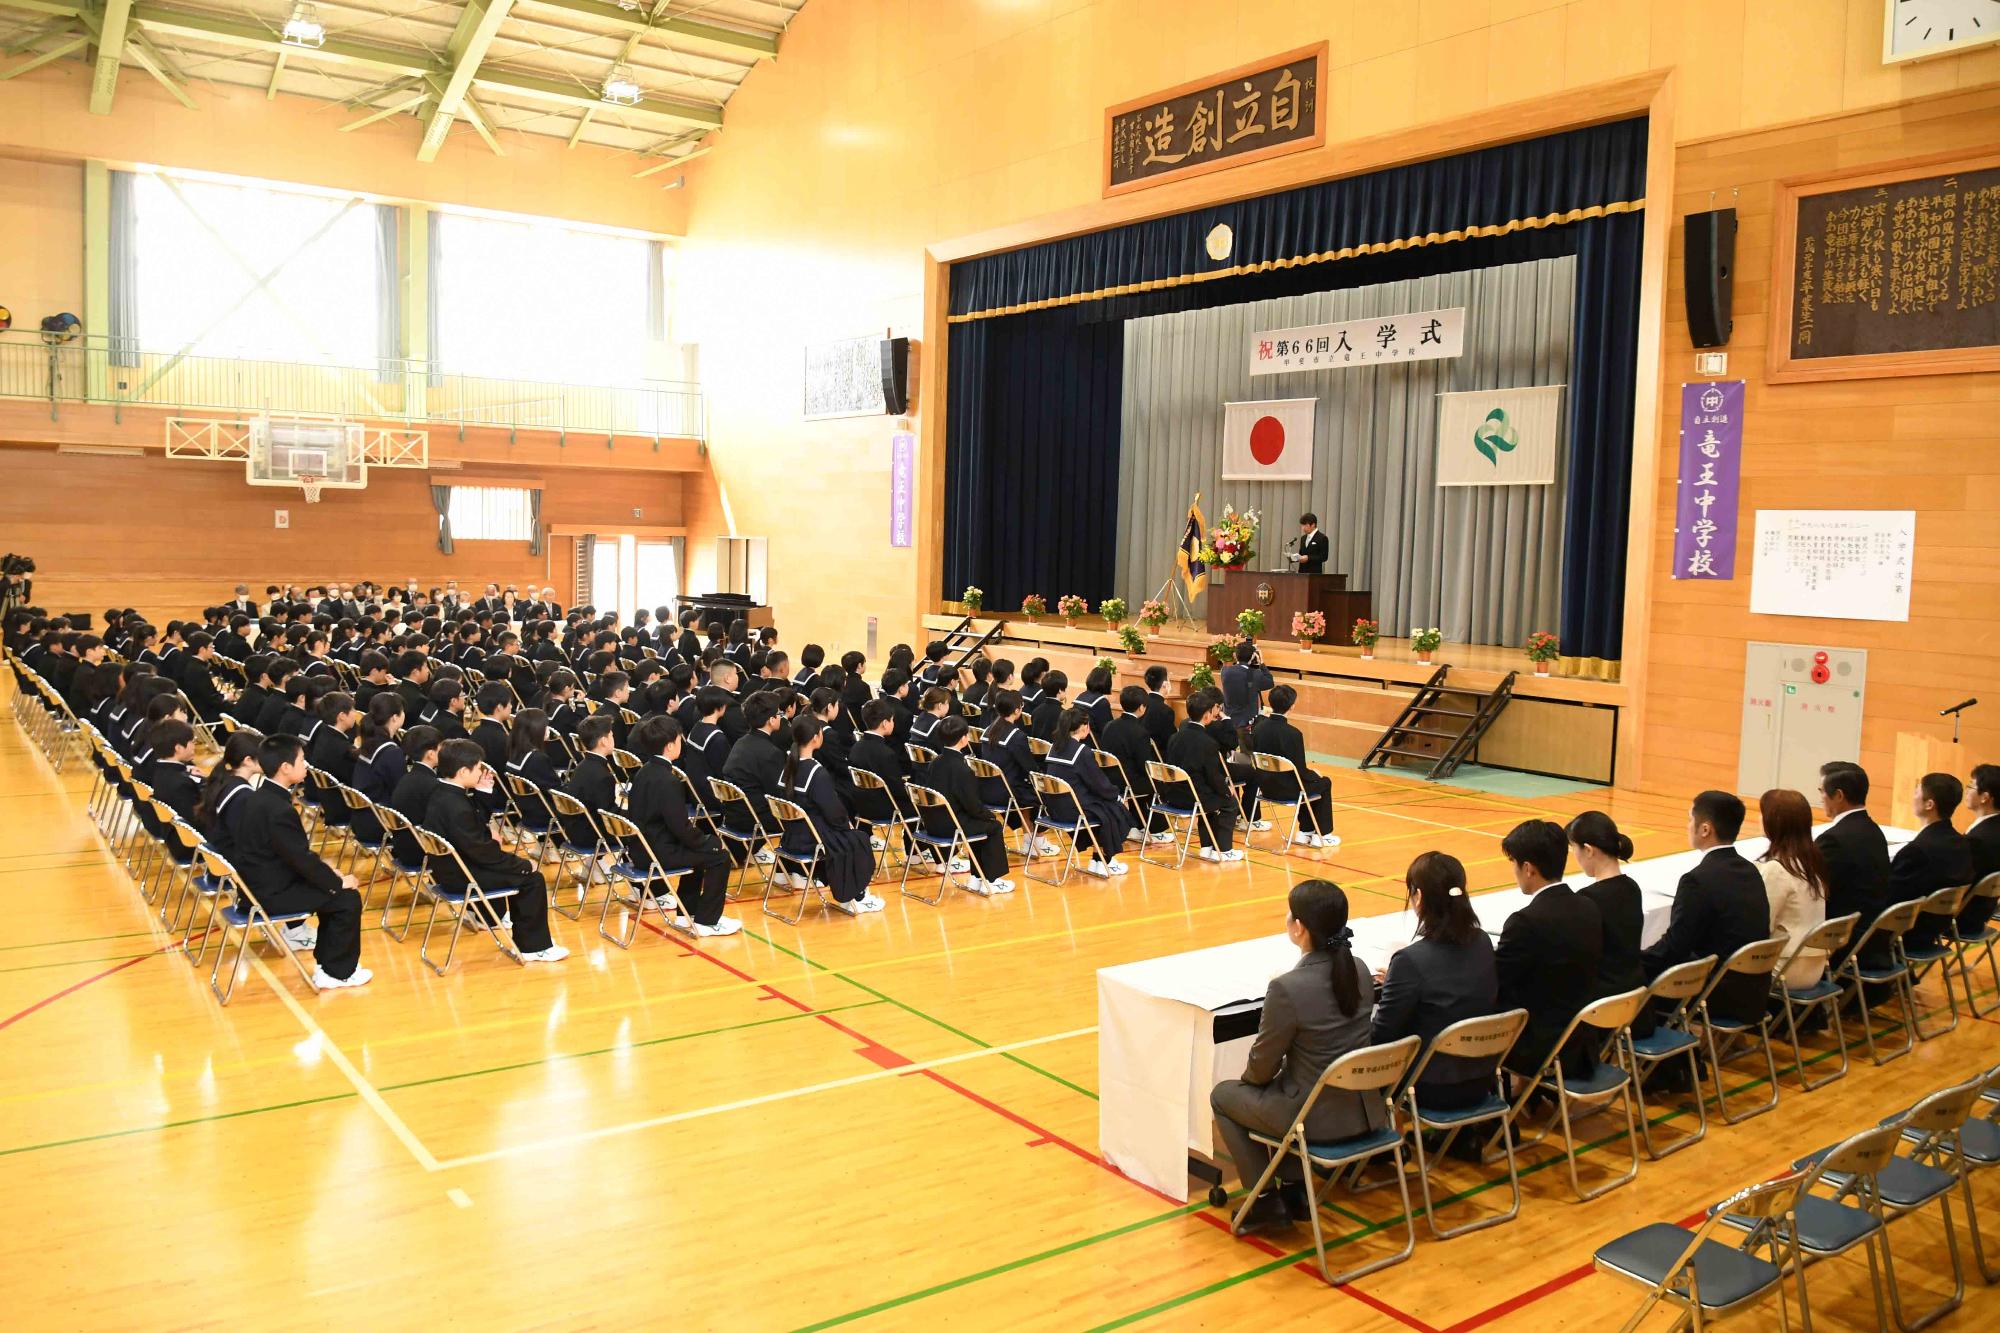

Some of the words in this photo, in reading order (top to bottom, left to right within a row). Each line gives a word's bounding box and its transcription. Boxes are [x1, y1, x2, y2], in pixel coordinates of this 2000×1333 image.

[1142, 68, 1302, 166] 自立創造
[1688, 429, 1722, 576] 竜王中学校
